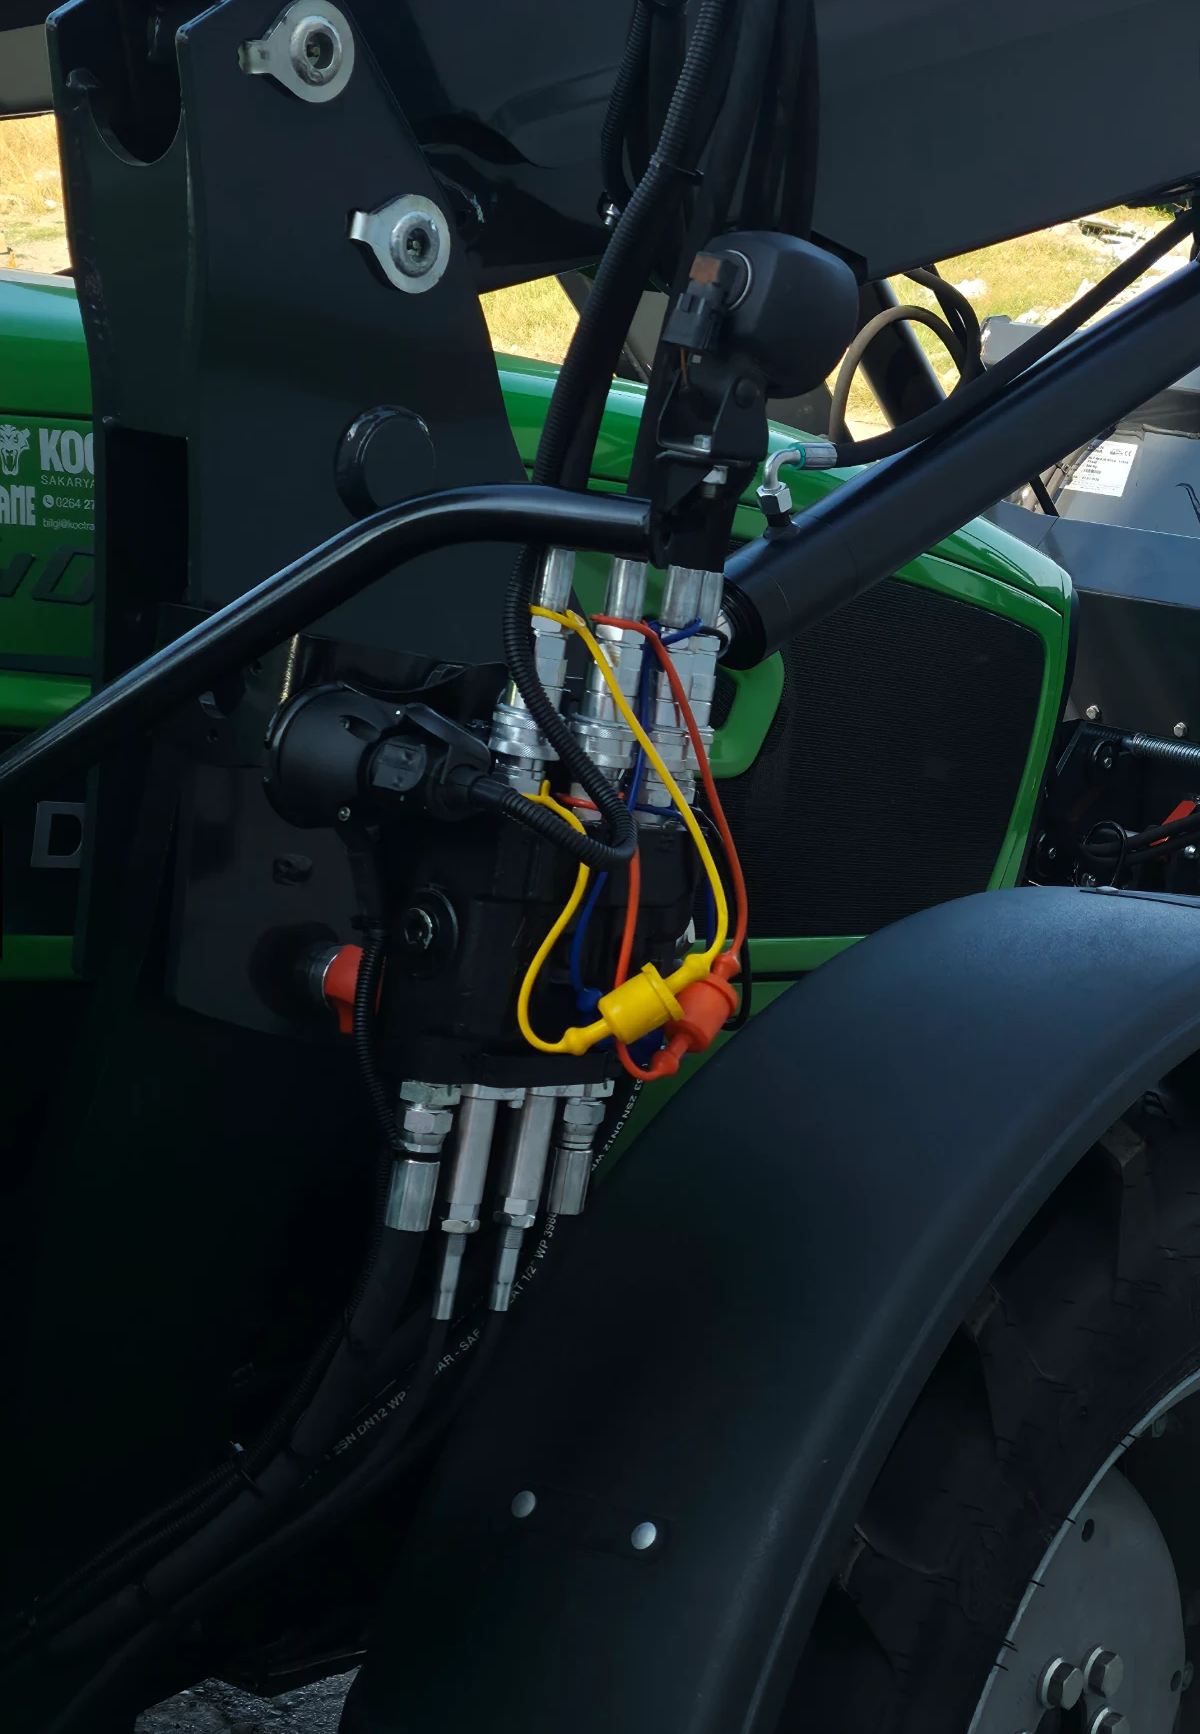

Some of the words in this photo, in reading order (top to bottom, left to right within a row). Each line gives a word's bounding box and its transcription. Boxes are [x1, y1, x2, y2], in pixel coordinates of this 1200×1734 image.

[56, 498, 81, 509] 0264
[622, 1095, 637, 1118] 2SN
[603, 1122, 624, 1151] DN12
[356, 1408, 388, 1435] DN12
[386, 1391, 406, 1410] WP
[521, 1260, 537, 1281] 1/2"
[534, 1239, 549, 1259] WP
